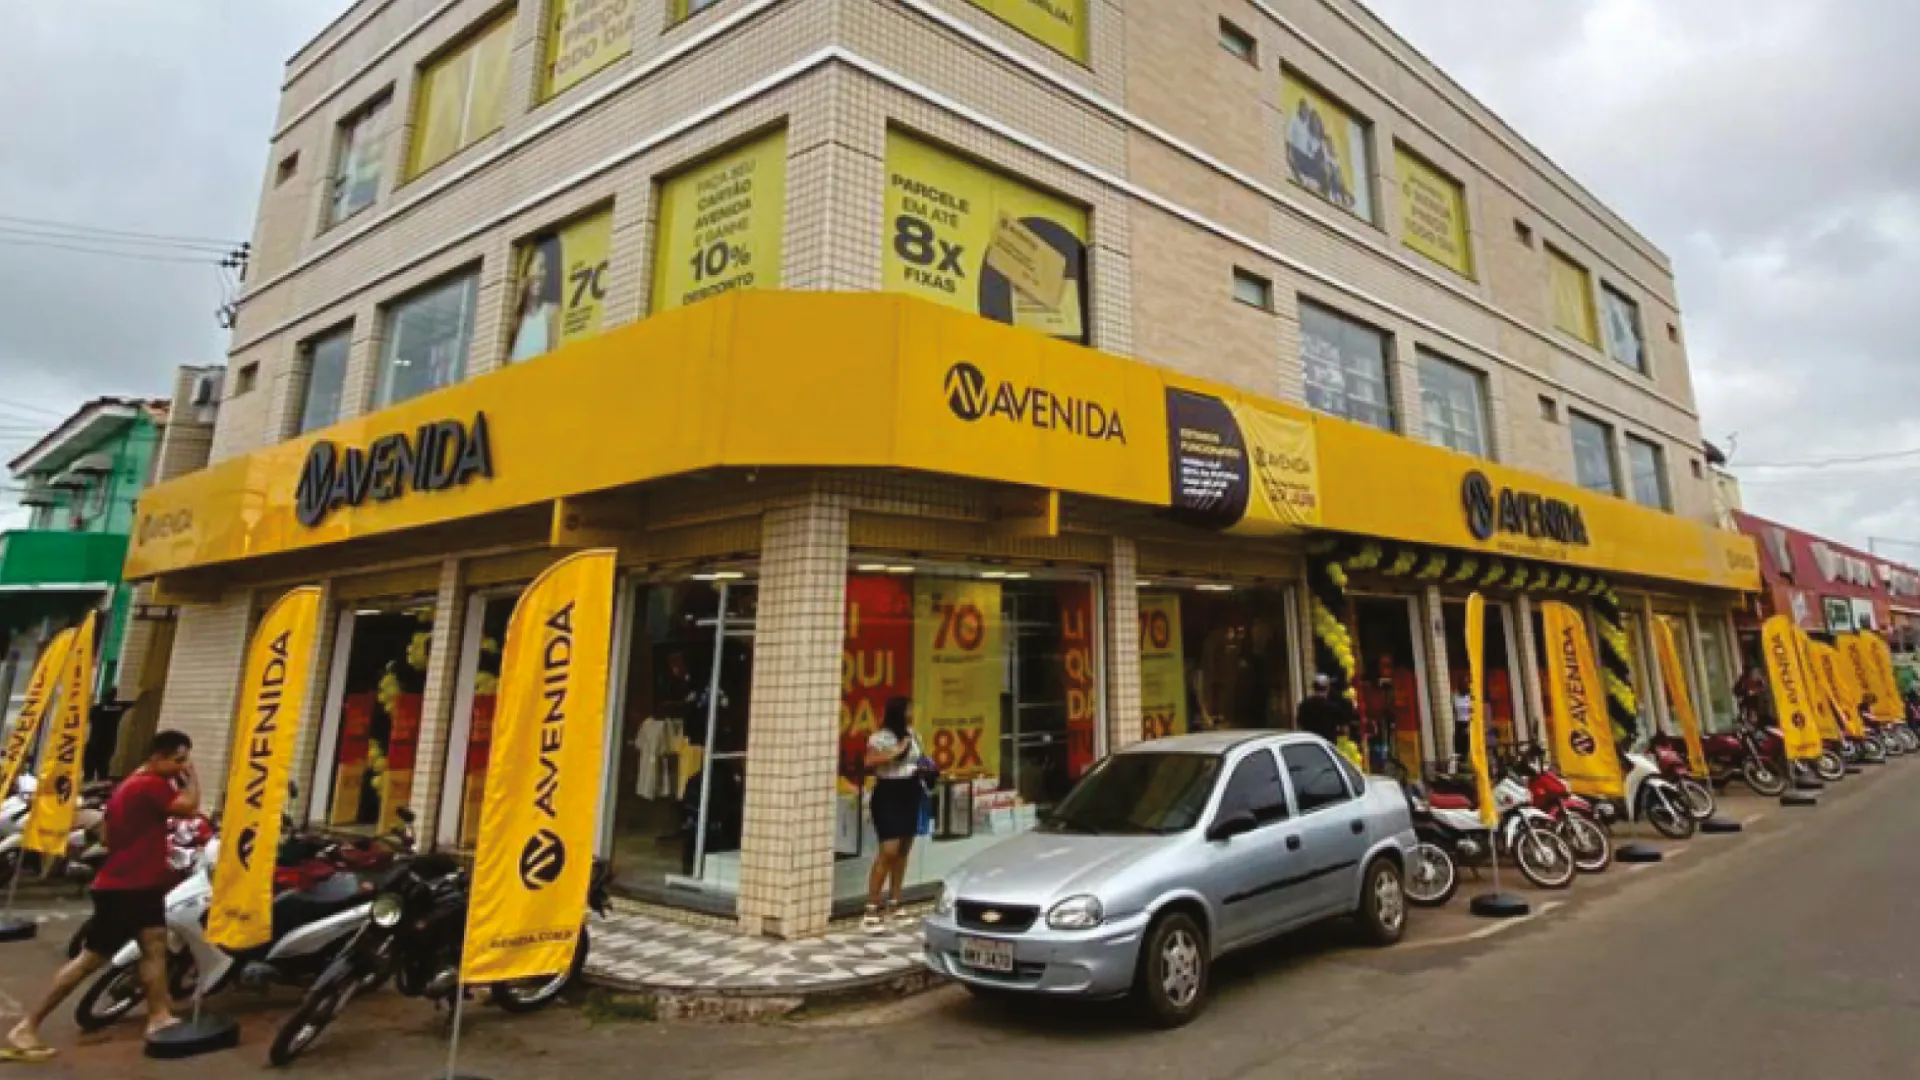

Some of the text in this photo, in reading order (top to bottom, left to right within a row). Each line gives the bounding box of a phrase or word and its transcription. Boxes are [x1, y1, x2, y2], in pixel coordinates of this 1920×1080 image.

[892, 173, 970, 214] PARCELE
[690, 240, 752, 281] 10%
[904, 264, 956, 293] FIXAS
[989, 380, 1128, 446] AVENIDA
[327, 409, 494, 509] AVENIDA
[1497, 486, 1590, 546] AVENIDA
[932, 604, 985, 651] 70
[1562, 626, 1589, 724] AVENIDA
[246, 629, 292, 810] AVENIDA
[534, 600, 576, 821] AVENIDA
